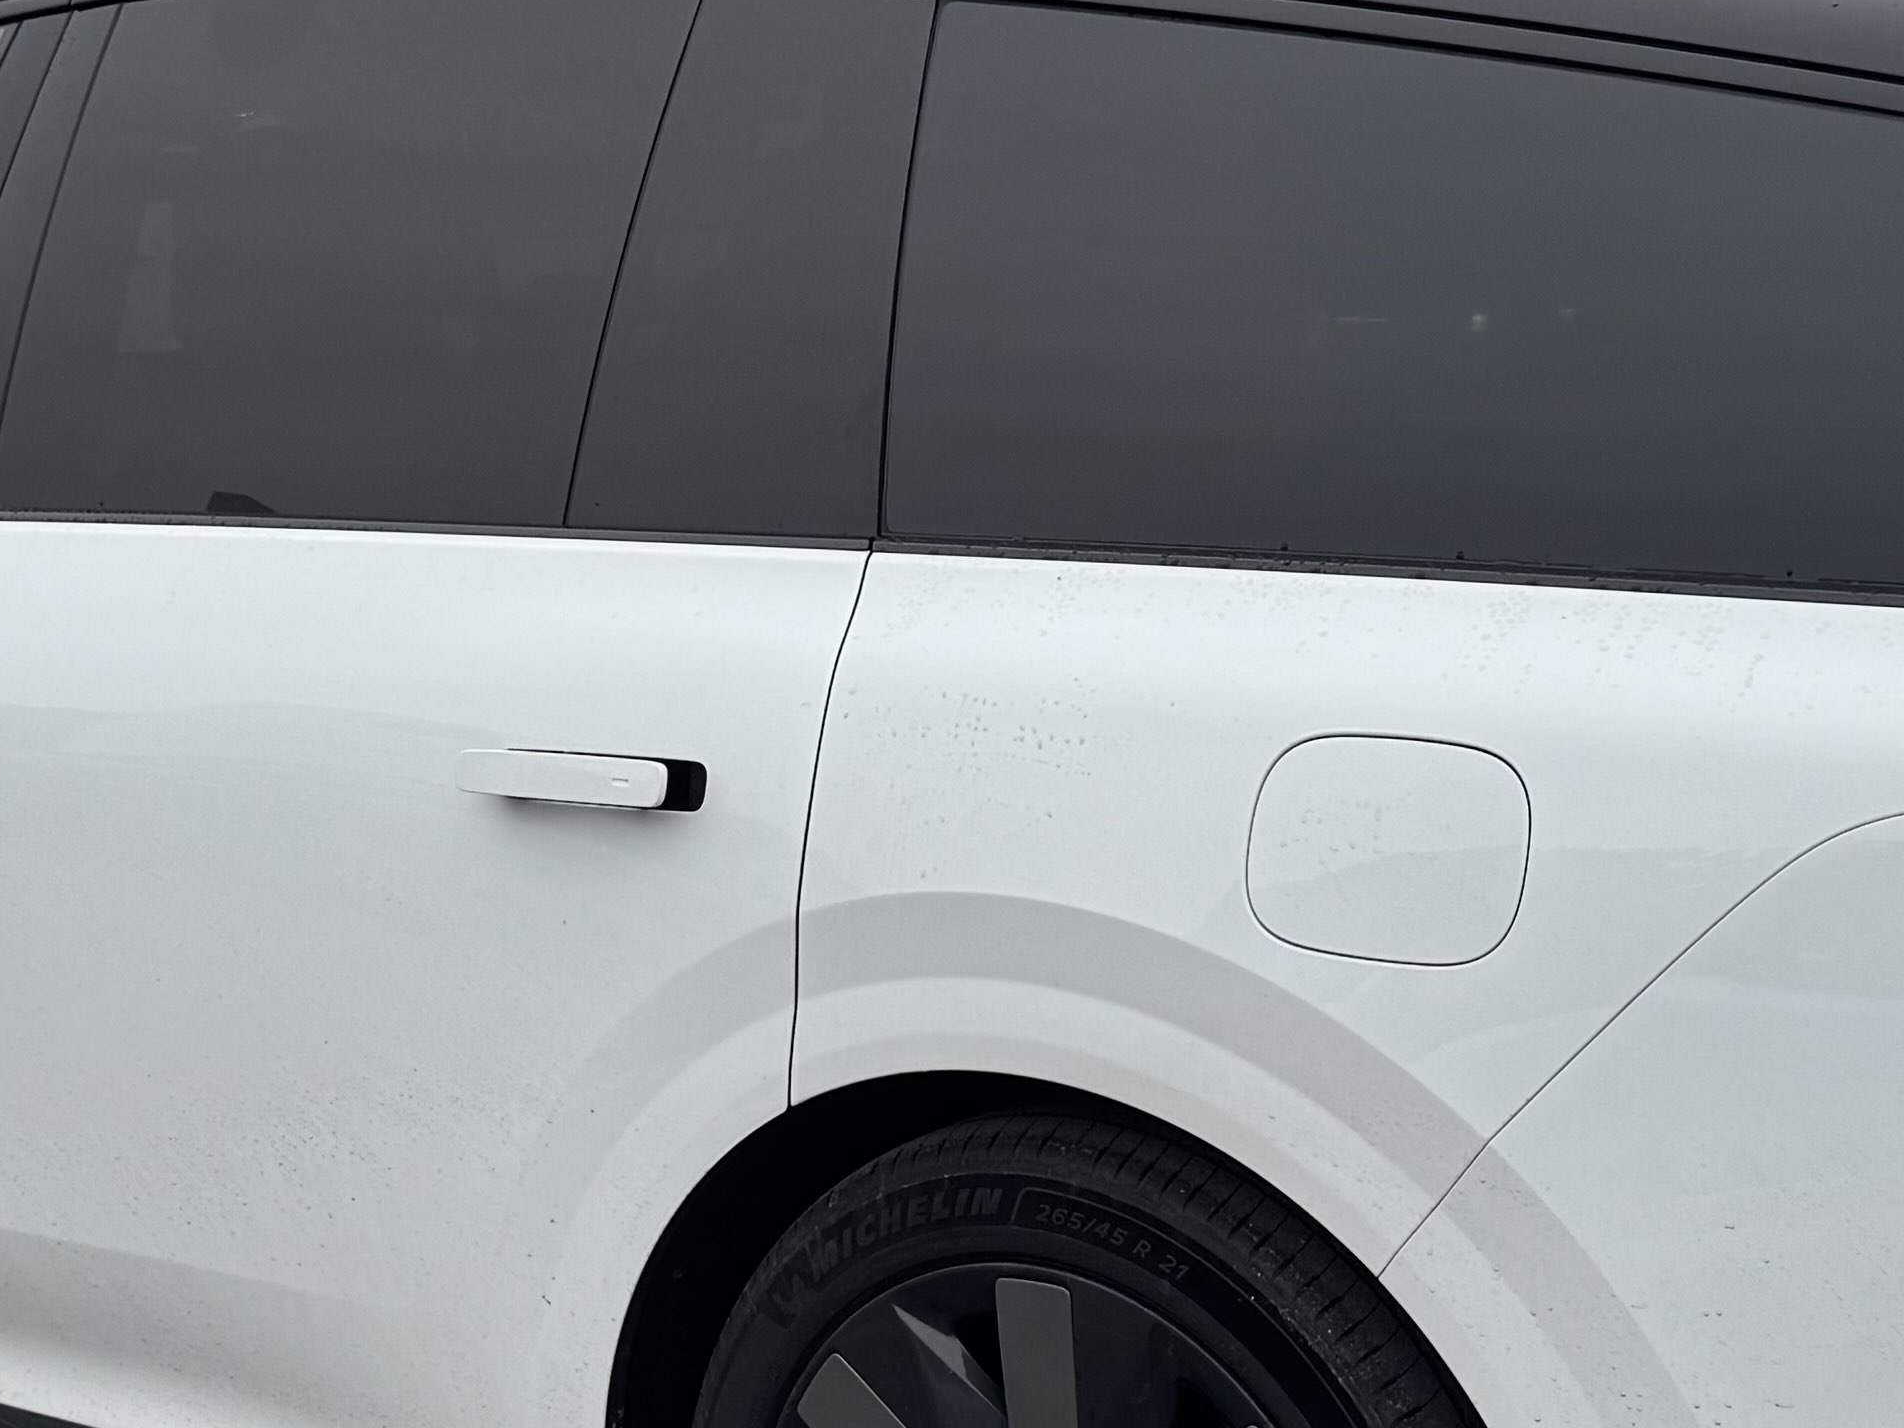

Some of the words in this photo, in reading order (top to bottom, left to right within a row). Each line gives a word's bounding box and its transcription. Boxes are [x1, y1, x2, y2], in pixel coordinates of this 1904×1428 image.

[807, 1187, 1003, 1280] MICHELIN
[1034, 1202, 1125, 1247] 265/45
[1131, 1237, 1152, 1260] R
[1157, 1253, 1191, 1280] 21
